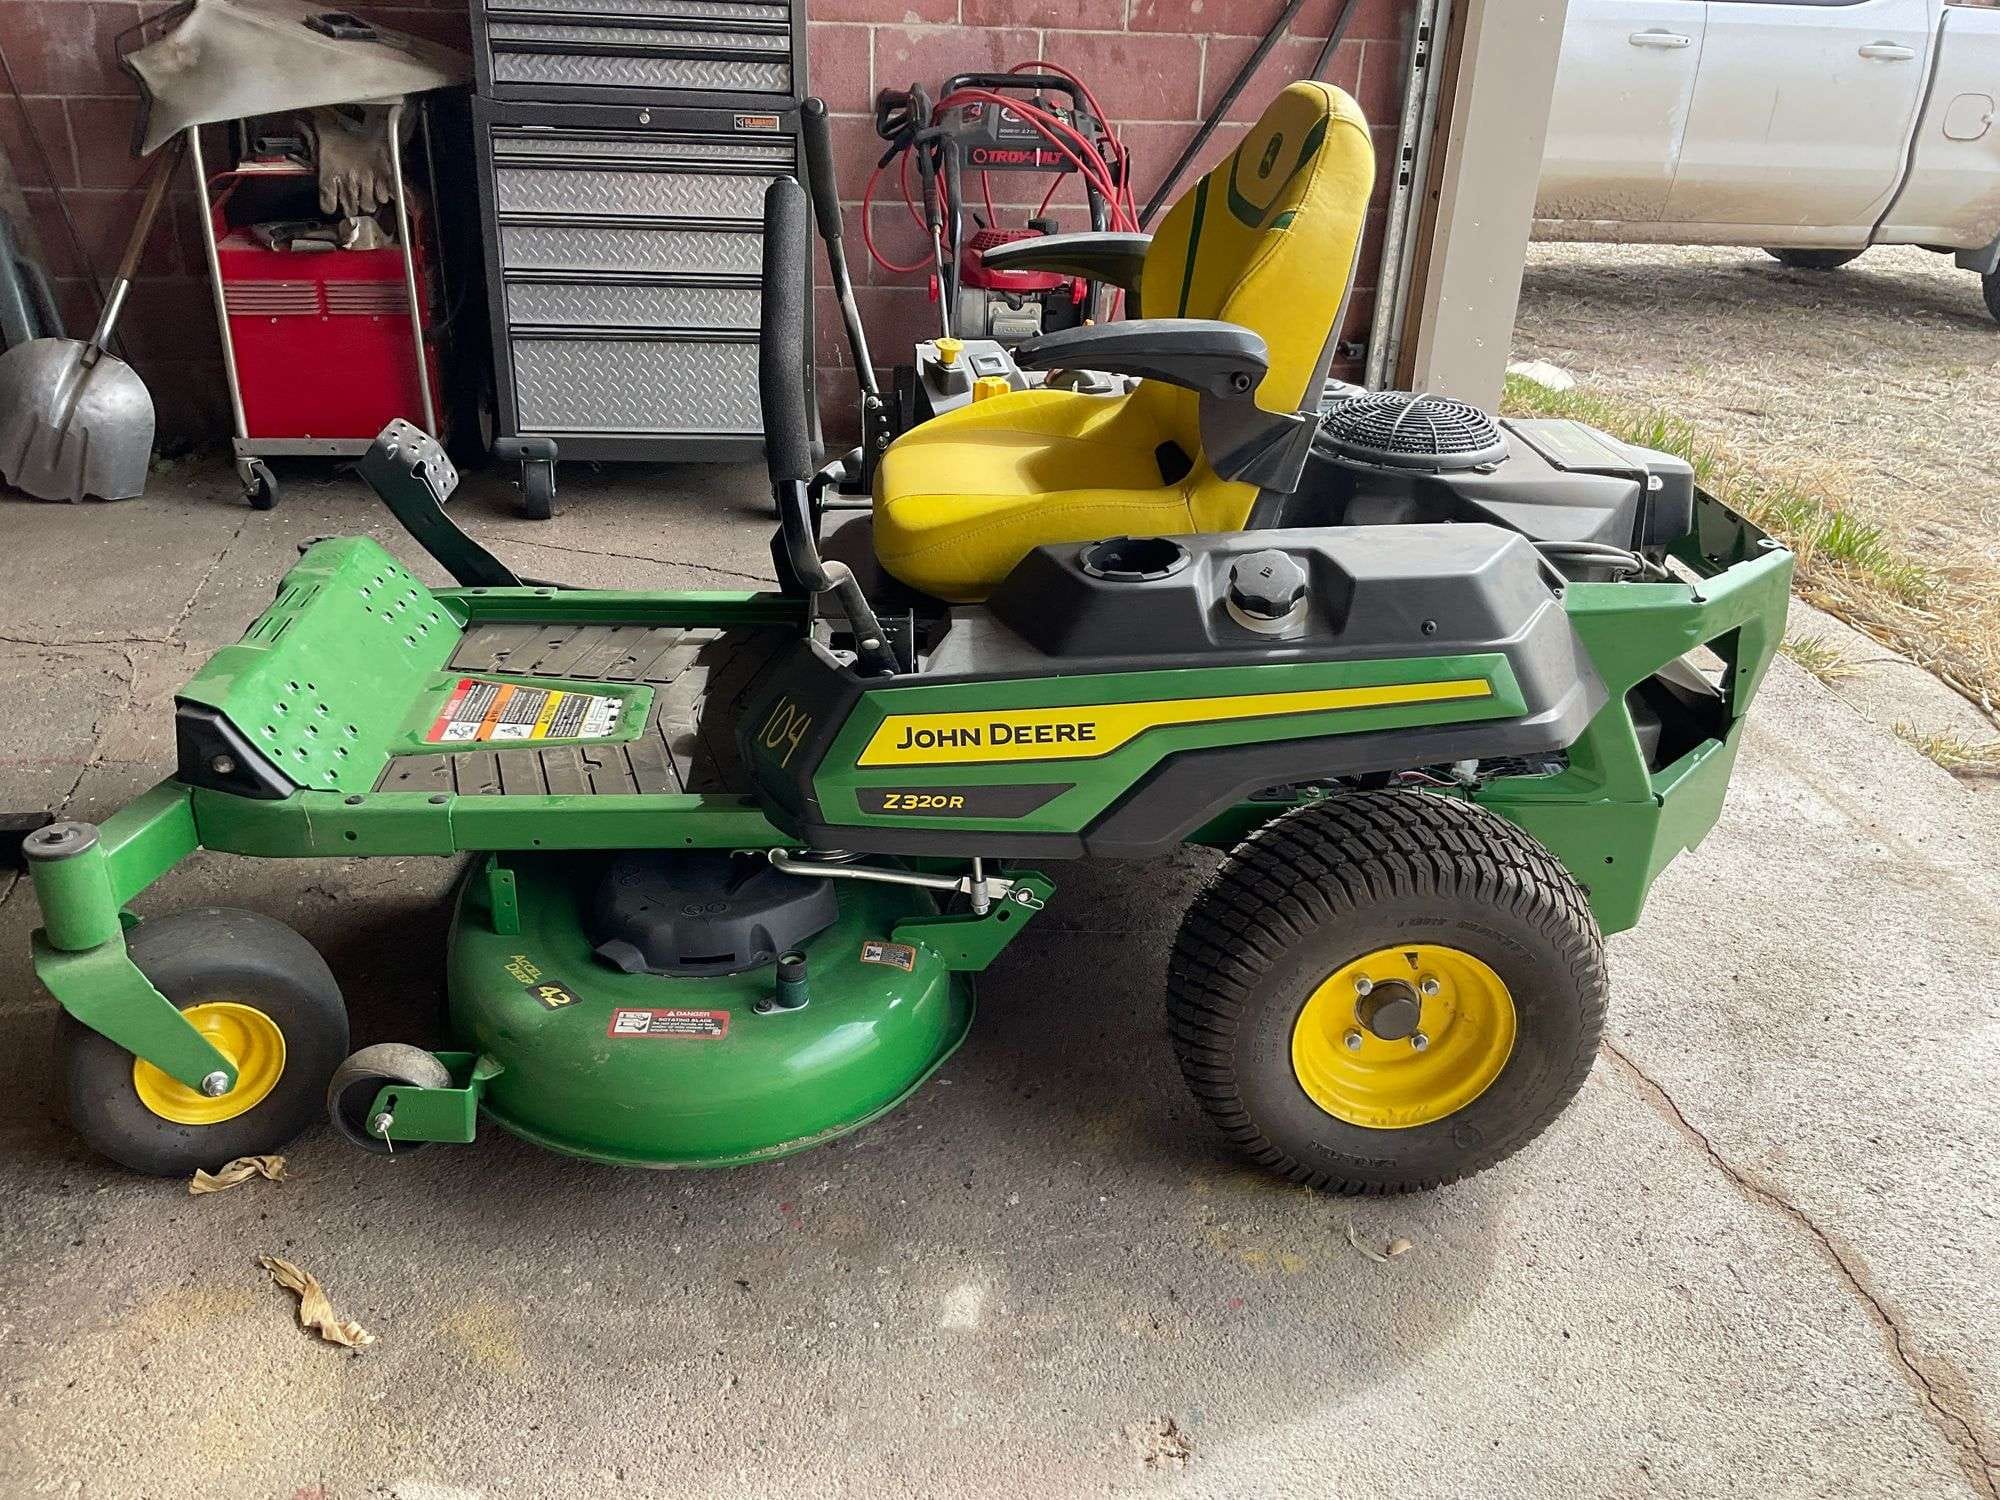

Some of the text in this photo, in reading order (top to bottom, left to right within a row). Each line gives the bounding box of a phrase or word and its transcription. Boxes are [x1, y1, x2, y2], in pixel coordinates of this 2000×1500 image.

[758, 696, 812, 769] 104
[897, 722, 1096, 750] JOHN DEERE
[504, 962, 534, 984] DEEP
[510, 955, 542, 980] ACCEL
[538, 986, 571, 1007] 42
